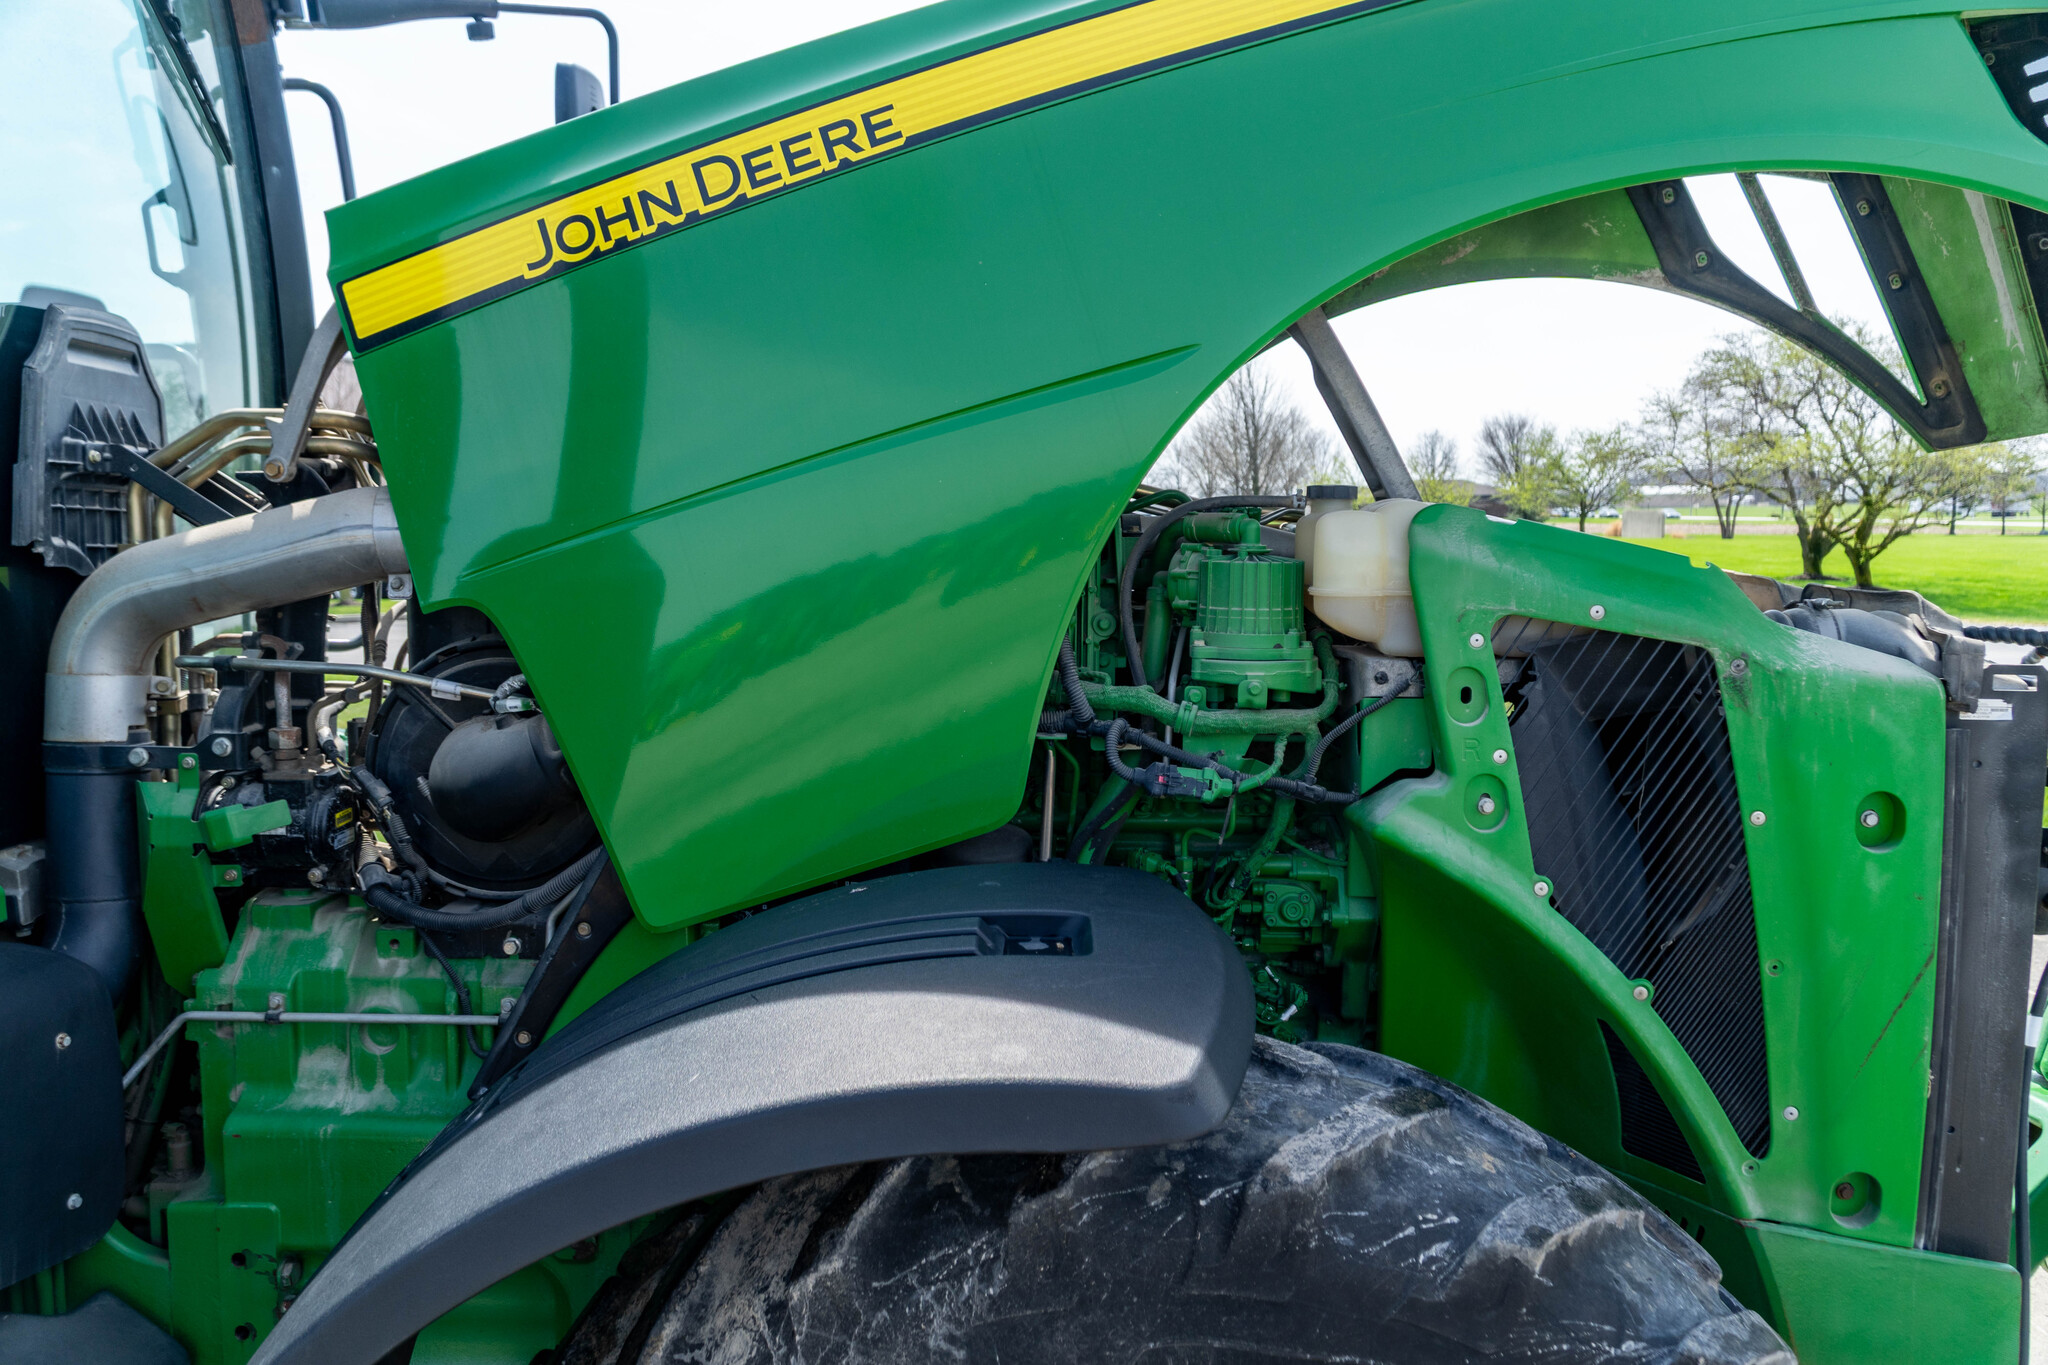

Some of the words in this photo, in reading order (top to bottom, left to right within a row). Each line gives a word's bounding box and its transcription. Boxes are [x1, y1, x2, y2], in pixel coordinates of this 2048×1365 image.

[526, 180, 684, 272] JOHN
[691, 103, 904, 207] DEERE
[1462, 737, 1480, 762] R
